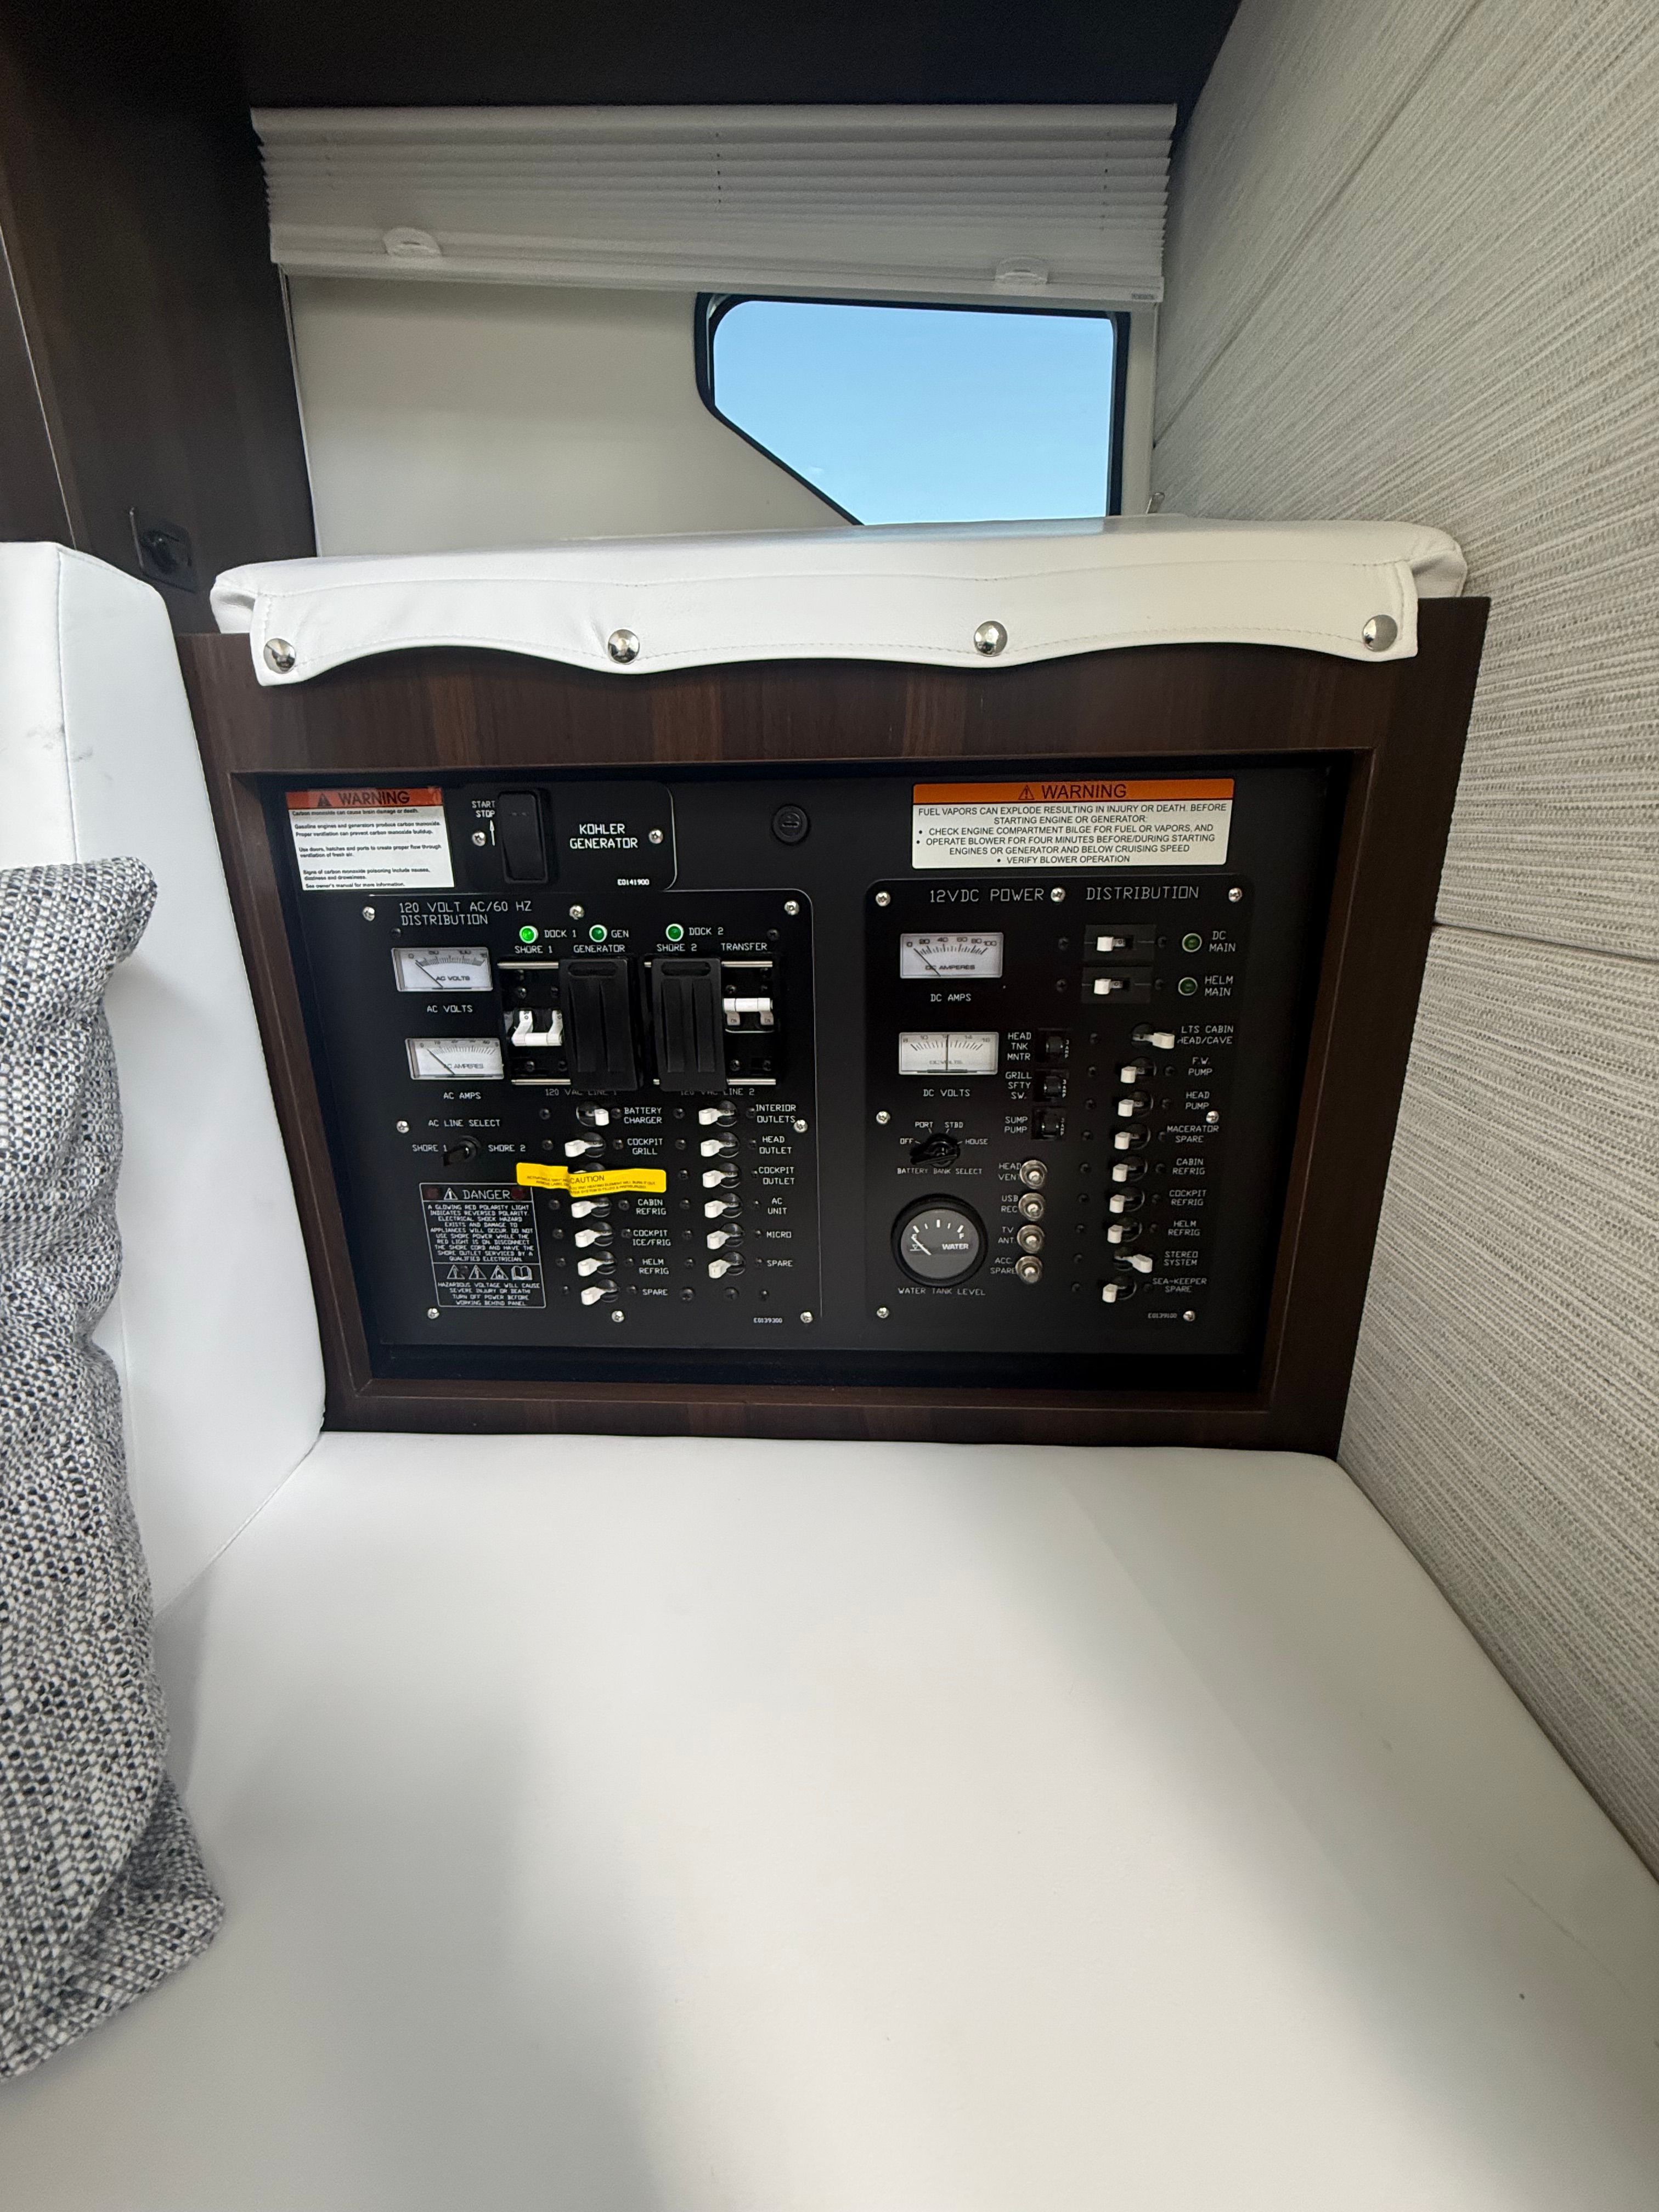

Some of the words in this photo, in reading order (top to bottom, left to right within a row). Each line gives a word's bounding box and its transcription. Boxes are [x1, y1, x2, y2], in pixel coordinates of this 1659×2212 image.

[1041, 783, 1127, 799] WARNING
[339, 791, 410, 805] WARNING
[1044, 805, 1093, 814] RESULTING
[579, 823, 625, 834] KOHLER
[570, 838, 638, 849] GENERATOR
[930, 890, 979, 902] 12VDC
[990, 889, 1044, 901] POWER
[1086, 887, 1199, 900] DISTRIBUTION
[399, 903, 419, 913] 120
[427, 902, 461, 913] VOLT
[470, 901, 508, 912] AC/60
[516, 901, 532, 911] HZ
[402, 915, 488, 926] DISTRIBUTION
[544, 929, 567, 938] DOCK
[611, 930, 629, 938] GEN
[689, 927, 712, 935] DOCK
[1212, 931, 1226, 940] DC
[657, 944, 685, 952] SHORE
[721, 943, 767, 951] TRANSFER
[1209, 943, 1235, 952] MAIN
[1205, 975, 1233, 985] HELM
[1205, 988, 1231, 996] MAIN
[930, 994, 941, 1002] DC
[570, 1175, 605, 1183] CAUTION
[462, 1190, 510, 1199] DANGER
